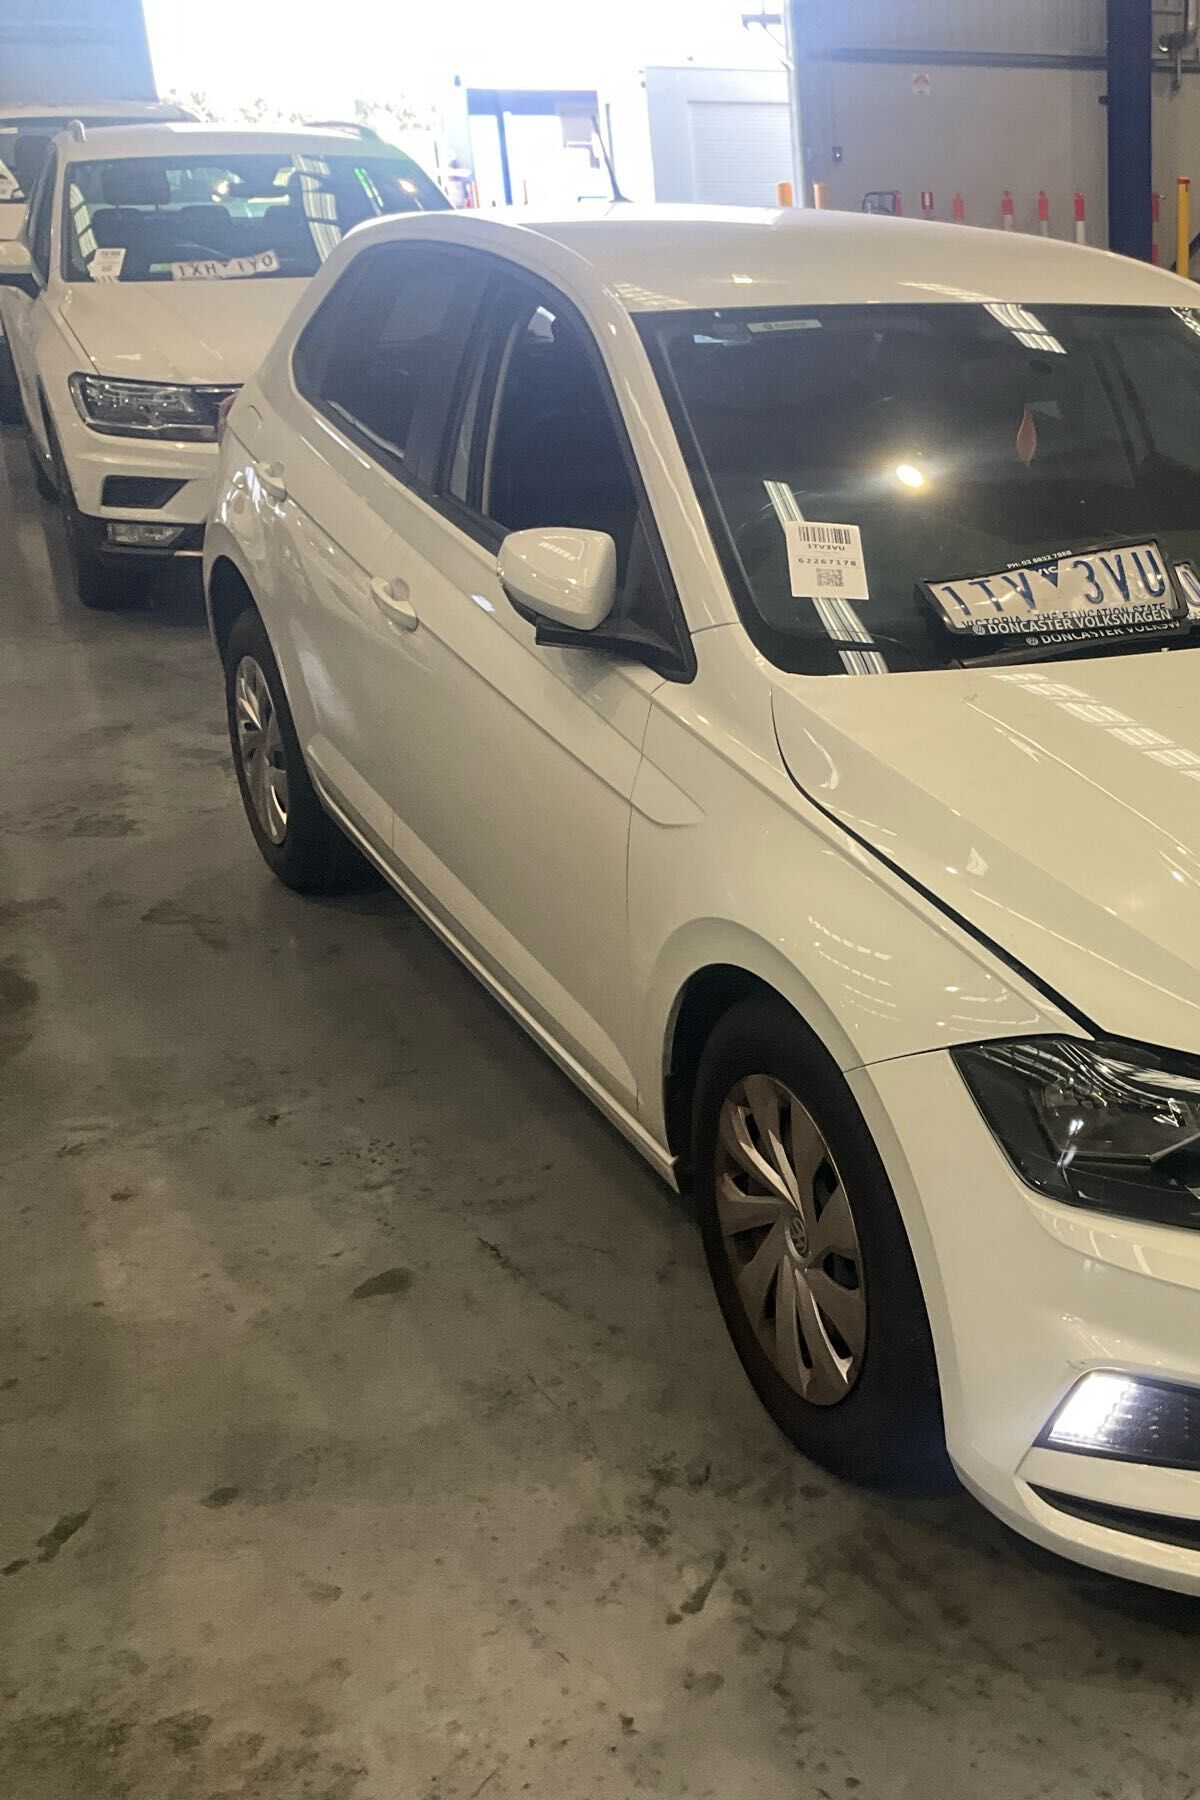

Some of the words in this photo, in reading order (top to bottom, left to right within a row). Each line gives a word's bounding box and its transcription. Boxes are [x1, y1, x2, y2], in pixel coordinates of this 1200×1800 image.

[808, 543, 845, 551] 1TV3VU
[798, 558, 857, 566] 62267178
[1038, 566, 1058, 575] VIC
[942, 572, 1036, 615] 1TV
[1072, 551, 1166, 604] 3VU
[987, 618, 1074, 634] DONCASTER
[1075, 608, 1171, 628] VOLKSWAGEN
